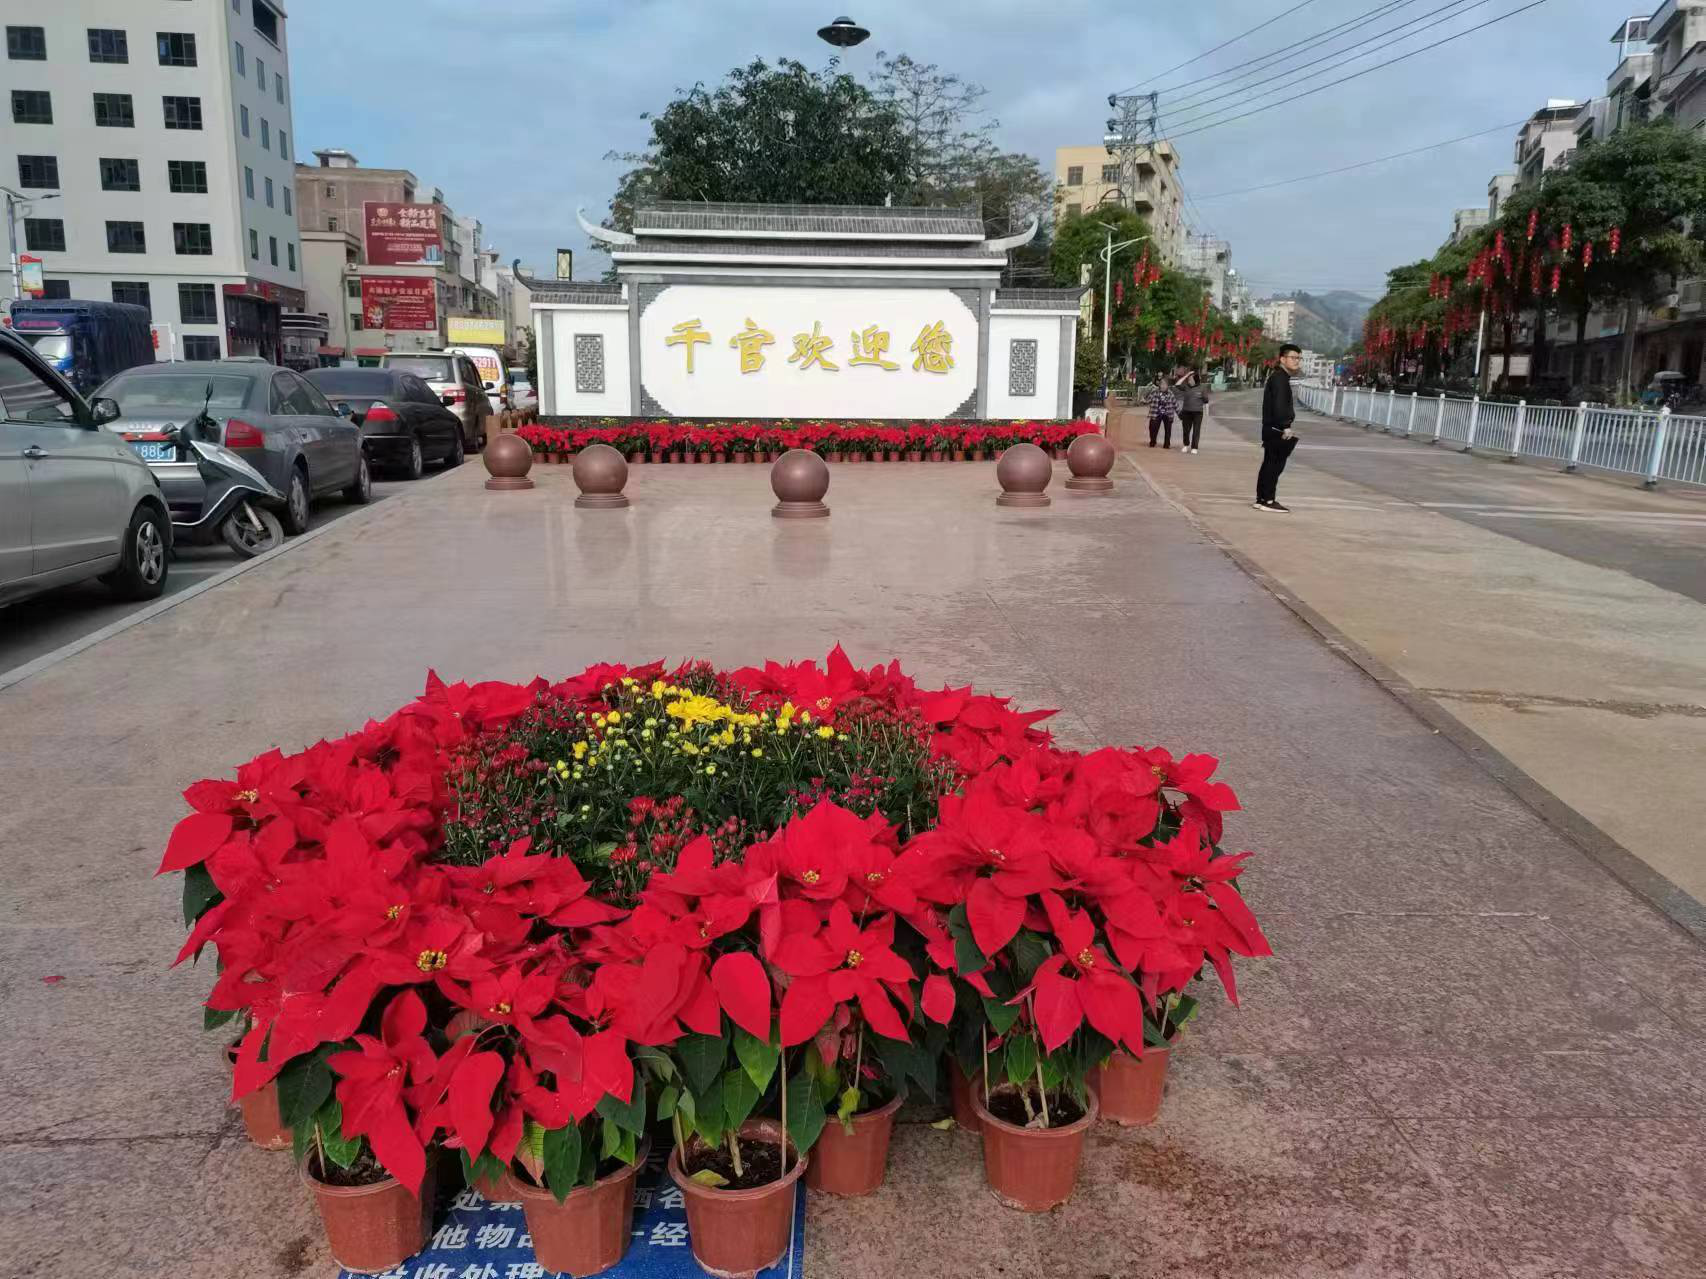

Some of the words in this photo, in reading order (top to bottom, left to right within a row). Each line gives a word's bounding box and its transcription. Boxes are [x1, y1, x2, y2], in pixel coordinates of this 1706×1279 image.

[665, 317, 955, 374] 千官欢迎您
